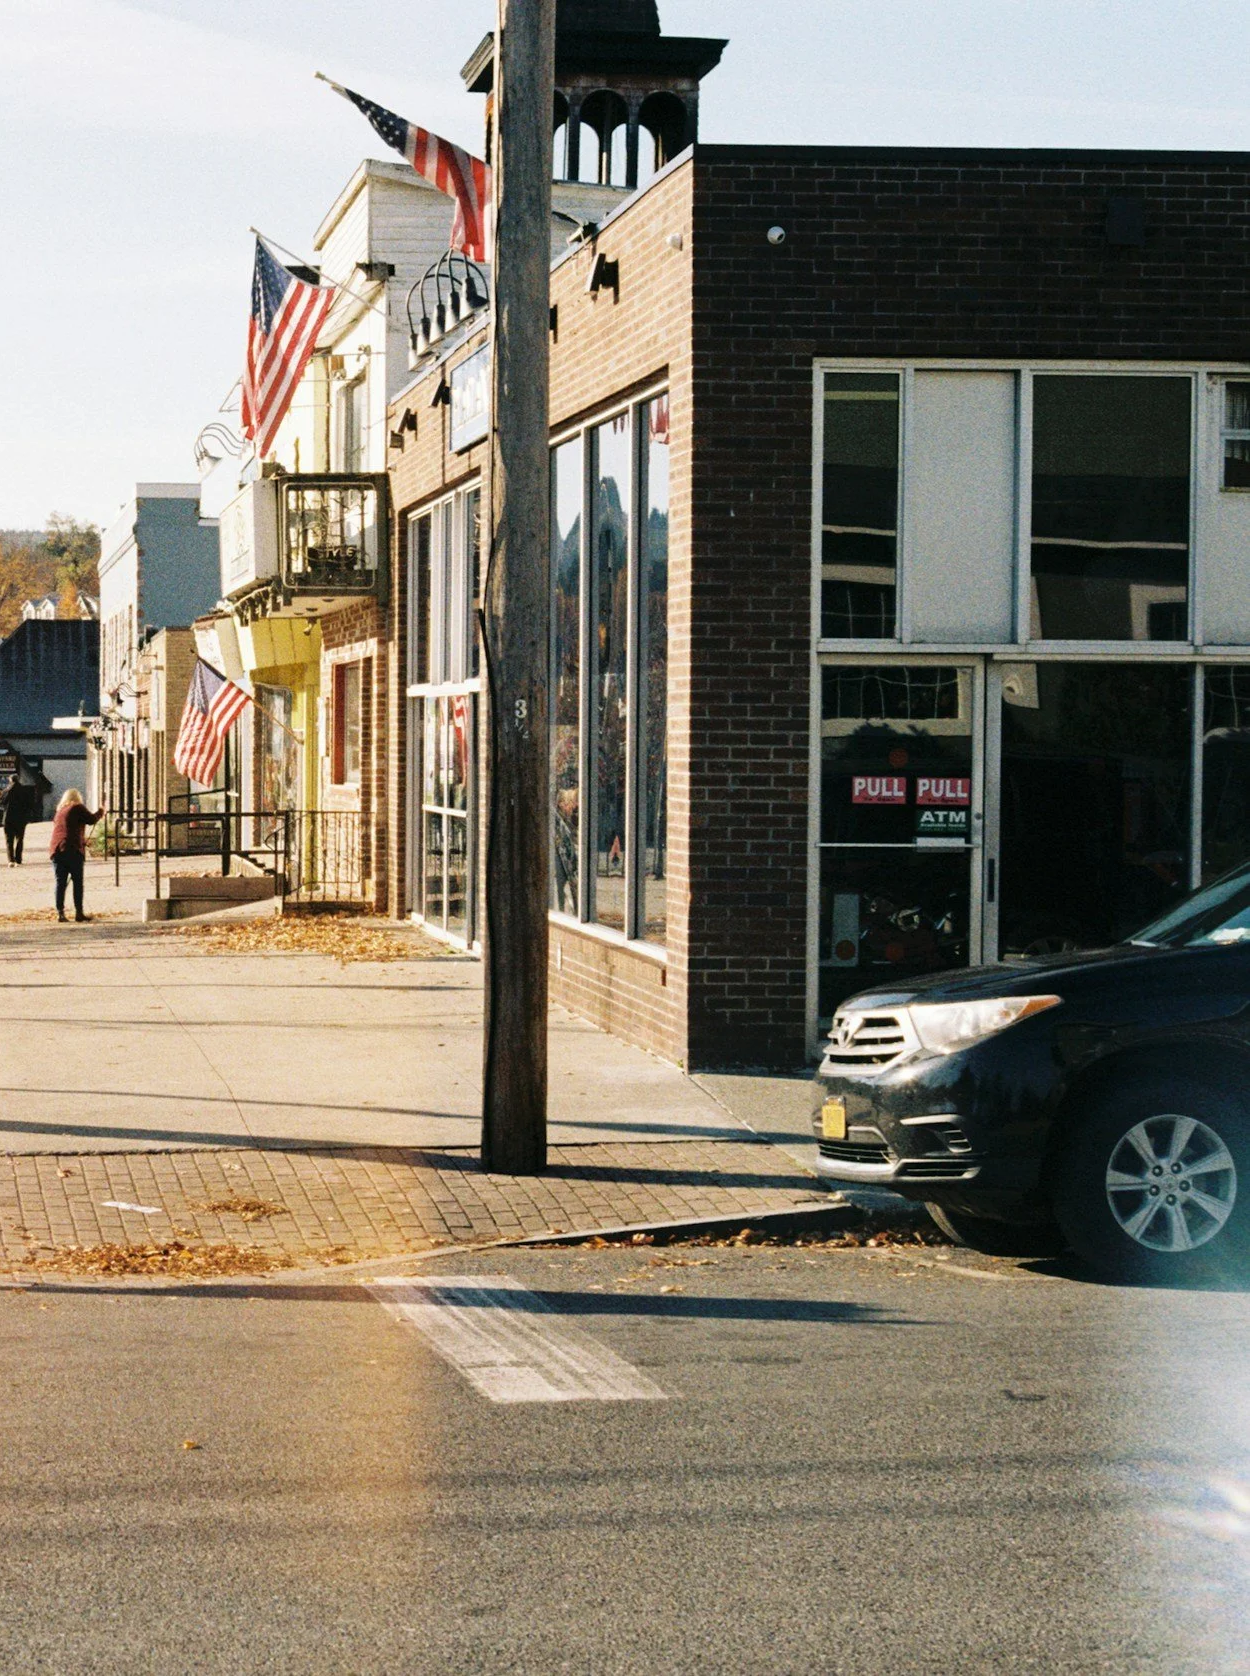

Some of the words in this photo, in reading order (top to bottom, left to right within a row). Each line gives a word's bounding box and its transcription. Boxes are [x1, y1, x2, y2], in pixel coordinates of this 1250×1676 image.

[515, 699, 527, 718] 3
[853, 777, 905, 797] PULL
[917, 779, 969, 798] PULL
[920, 811, 967, 823] ATM
